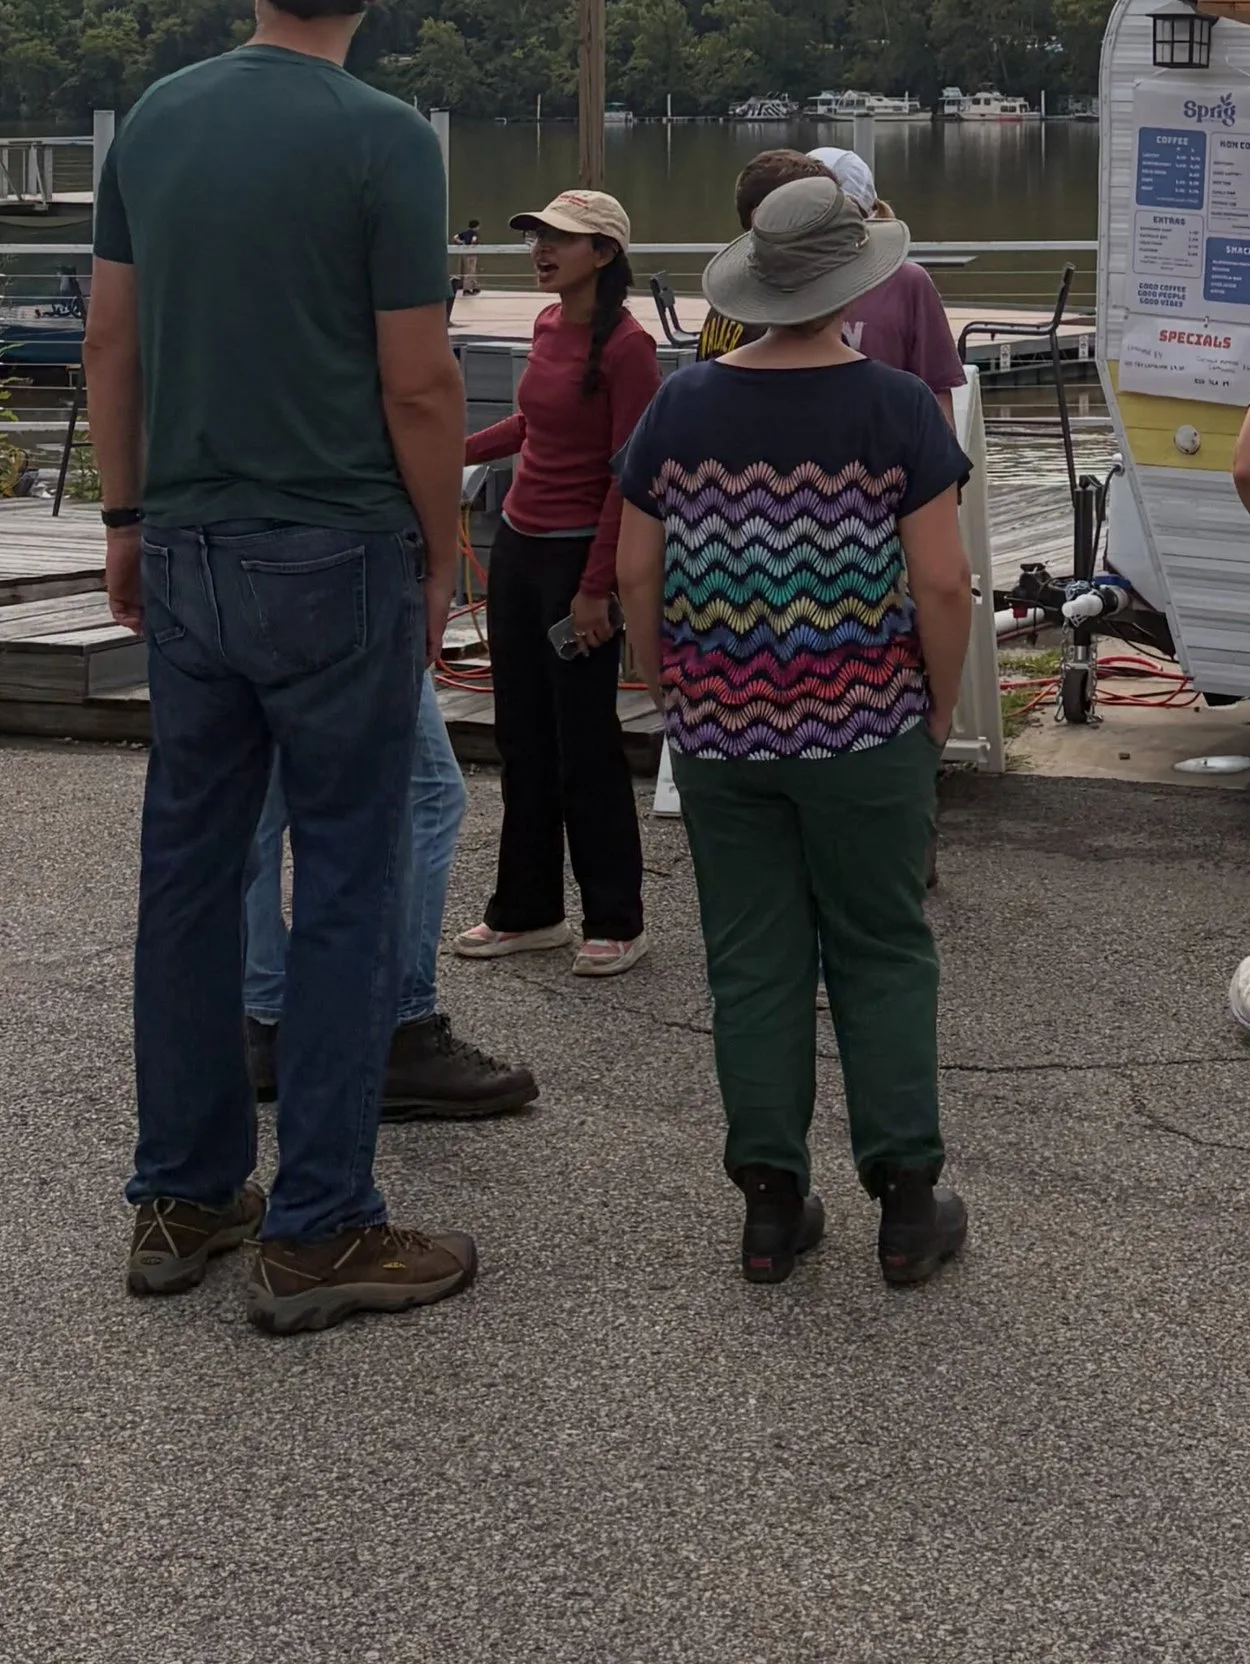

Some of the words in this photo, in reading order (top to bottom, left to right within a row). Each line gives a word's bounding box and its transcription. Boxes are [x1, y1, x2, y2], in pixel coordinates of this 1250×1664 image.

[1183, 97, 1237, 127] Sprig
[1156, 136, 1189, 146] COFFEE
[1220, 140, 1239, 149] NON
[1153, 216, 1186, 226] EXTRAS
[1139, 282, 1159, 291] GOOD
[1160, 284, 1187, 293] COFFEE
[1138, 290, 1158, 298] GOOD
[1158, 291, 1187, 301] PEOPLE
[1139, 297, 1159, 305] GOOD
[1159, 329, 1233, 350] SPECIALS
